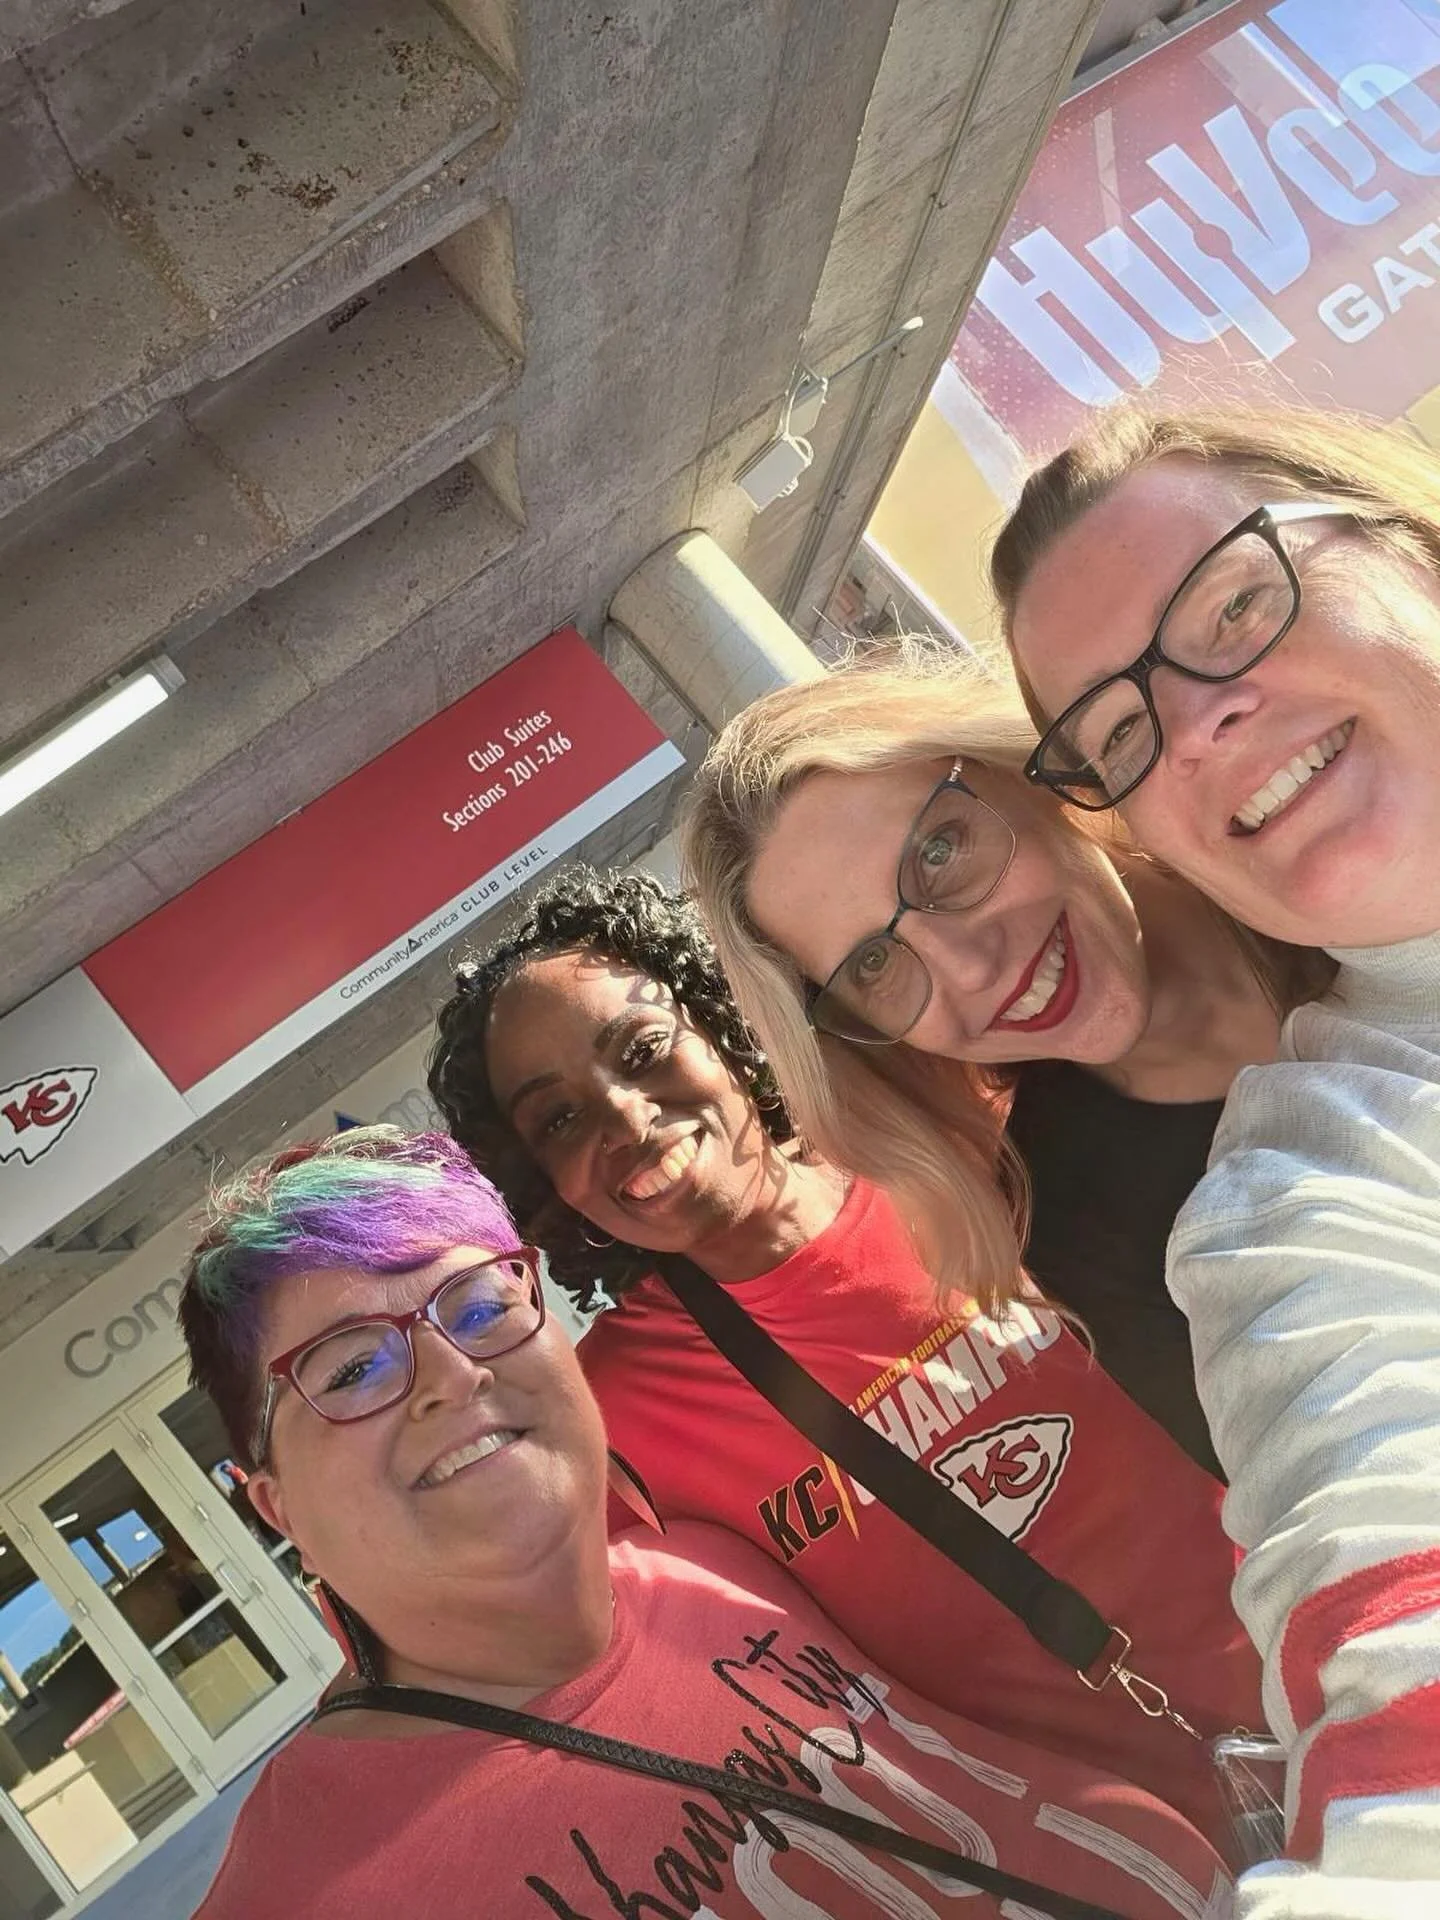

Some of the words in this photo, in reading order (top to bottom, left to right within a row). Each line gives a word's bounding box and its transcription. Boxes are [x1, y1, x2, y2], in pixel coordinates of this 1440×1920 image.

[468, 741, 505, 774] Club
[504, 709, 553, 749] Suites
[443, 781, 508, 832] Sections
[505, 732, 573, 787] 201-246
[461, 880, 500, 914] CLUB
[504, 846, 548, 883] LEVEL
[856, 1356, 912, 1414] AMERICAN
[957, 1433, 1051, 1509] KC
[756, 1465, 840, 1563] KC
[712, 1630, 890, 1767] City
